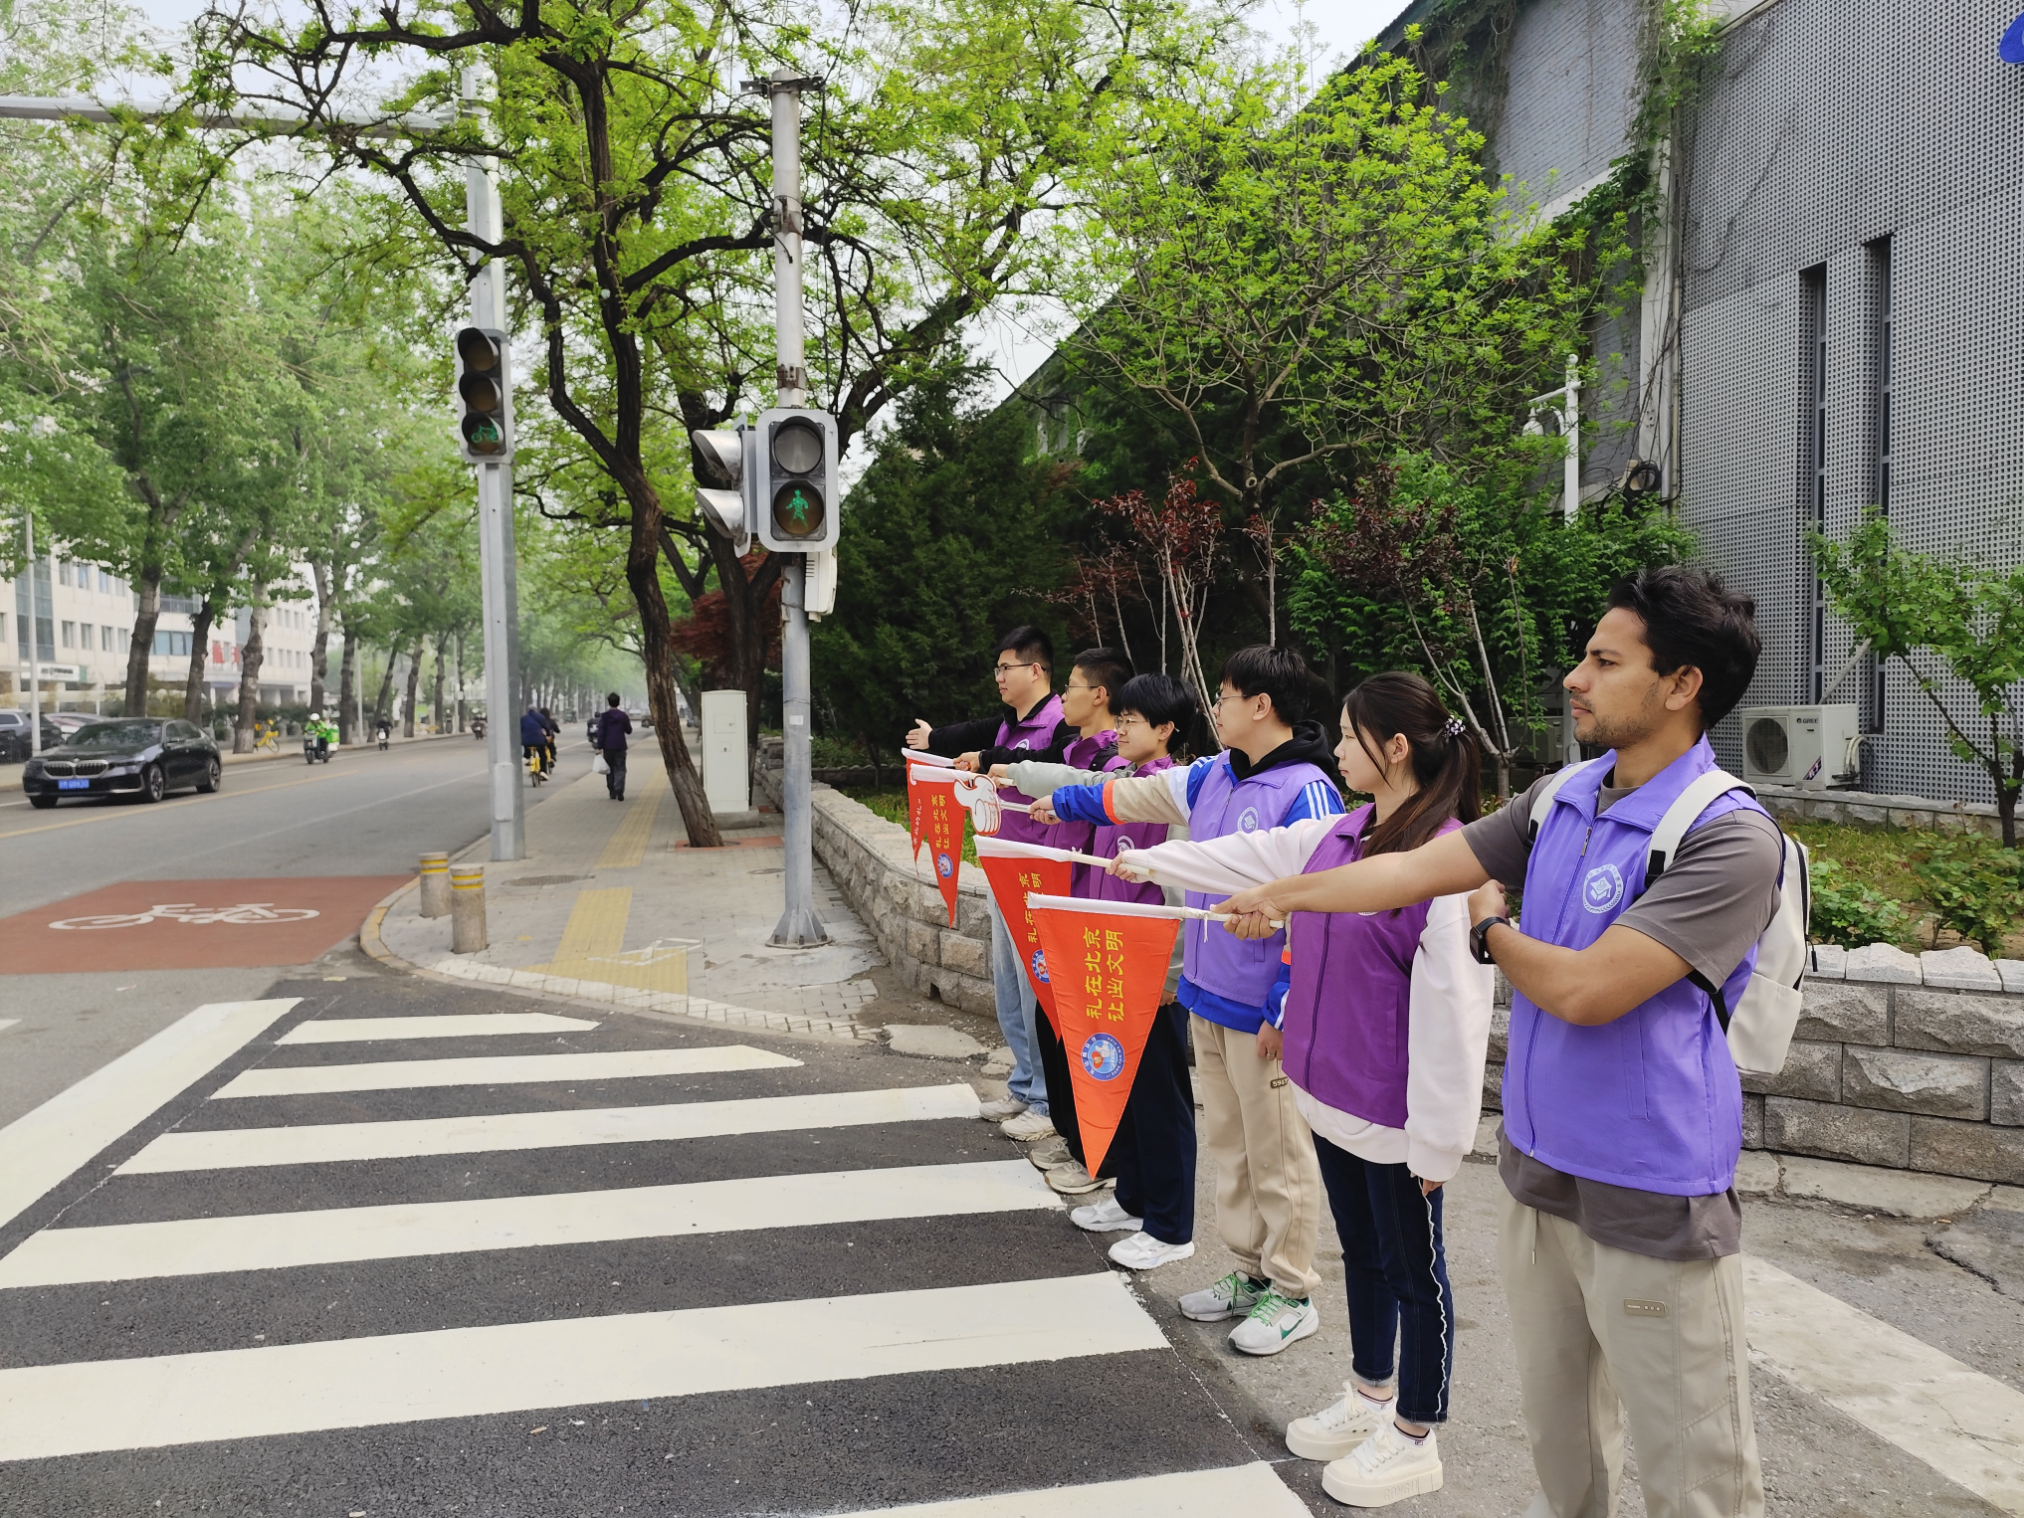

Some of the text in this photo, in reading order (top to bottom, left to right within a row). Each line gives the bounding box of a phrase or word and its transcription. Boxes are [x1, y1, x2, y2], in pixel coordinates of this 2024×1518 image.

[931, 794, 942, 849] 礼在北京
[939, 794, 950, 849] 让出文明
[1083, 926, 1103, 1019] 礼在北京
[1105, 929, 1125, 1021] 让出文明
